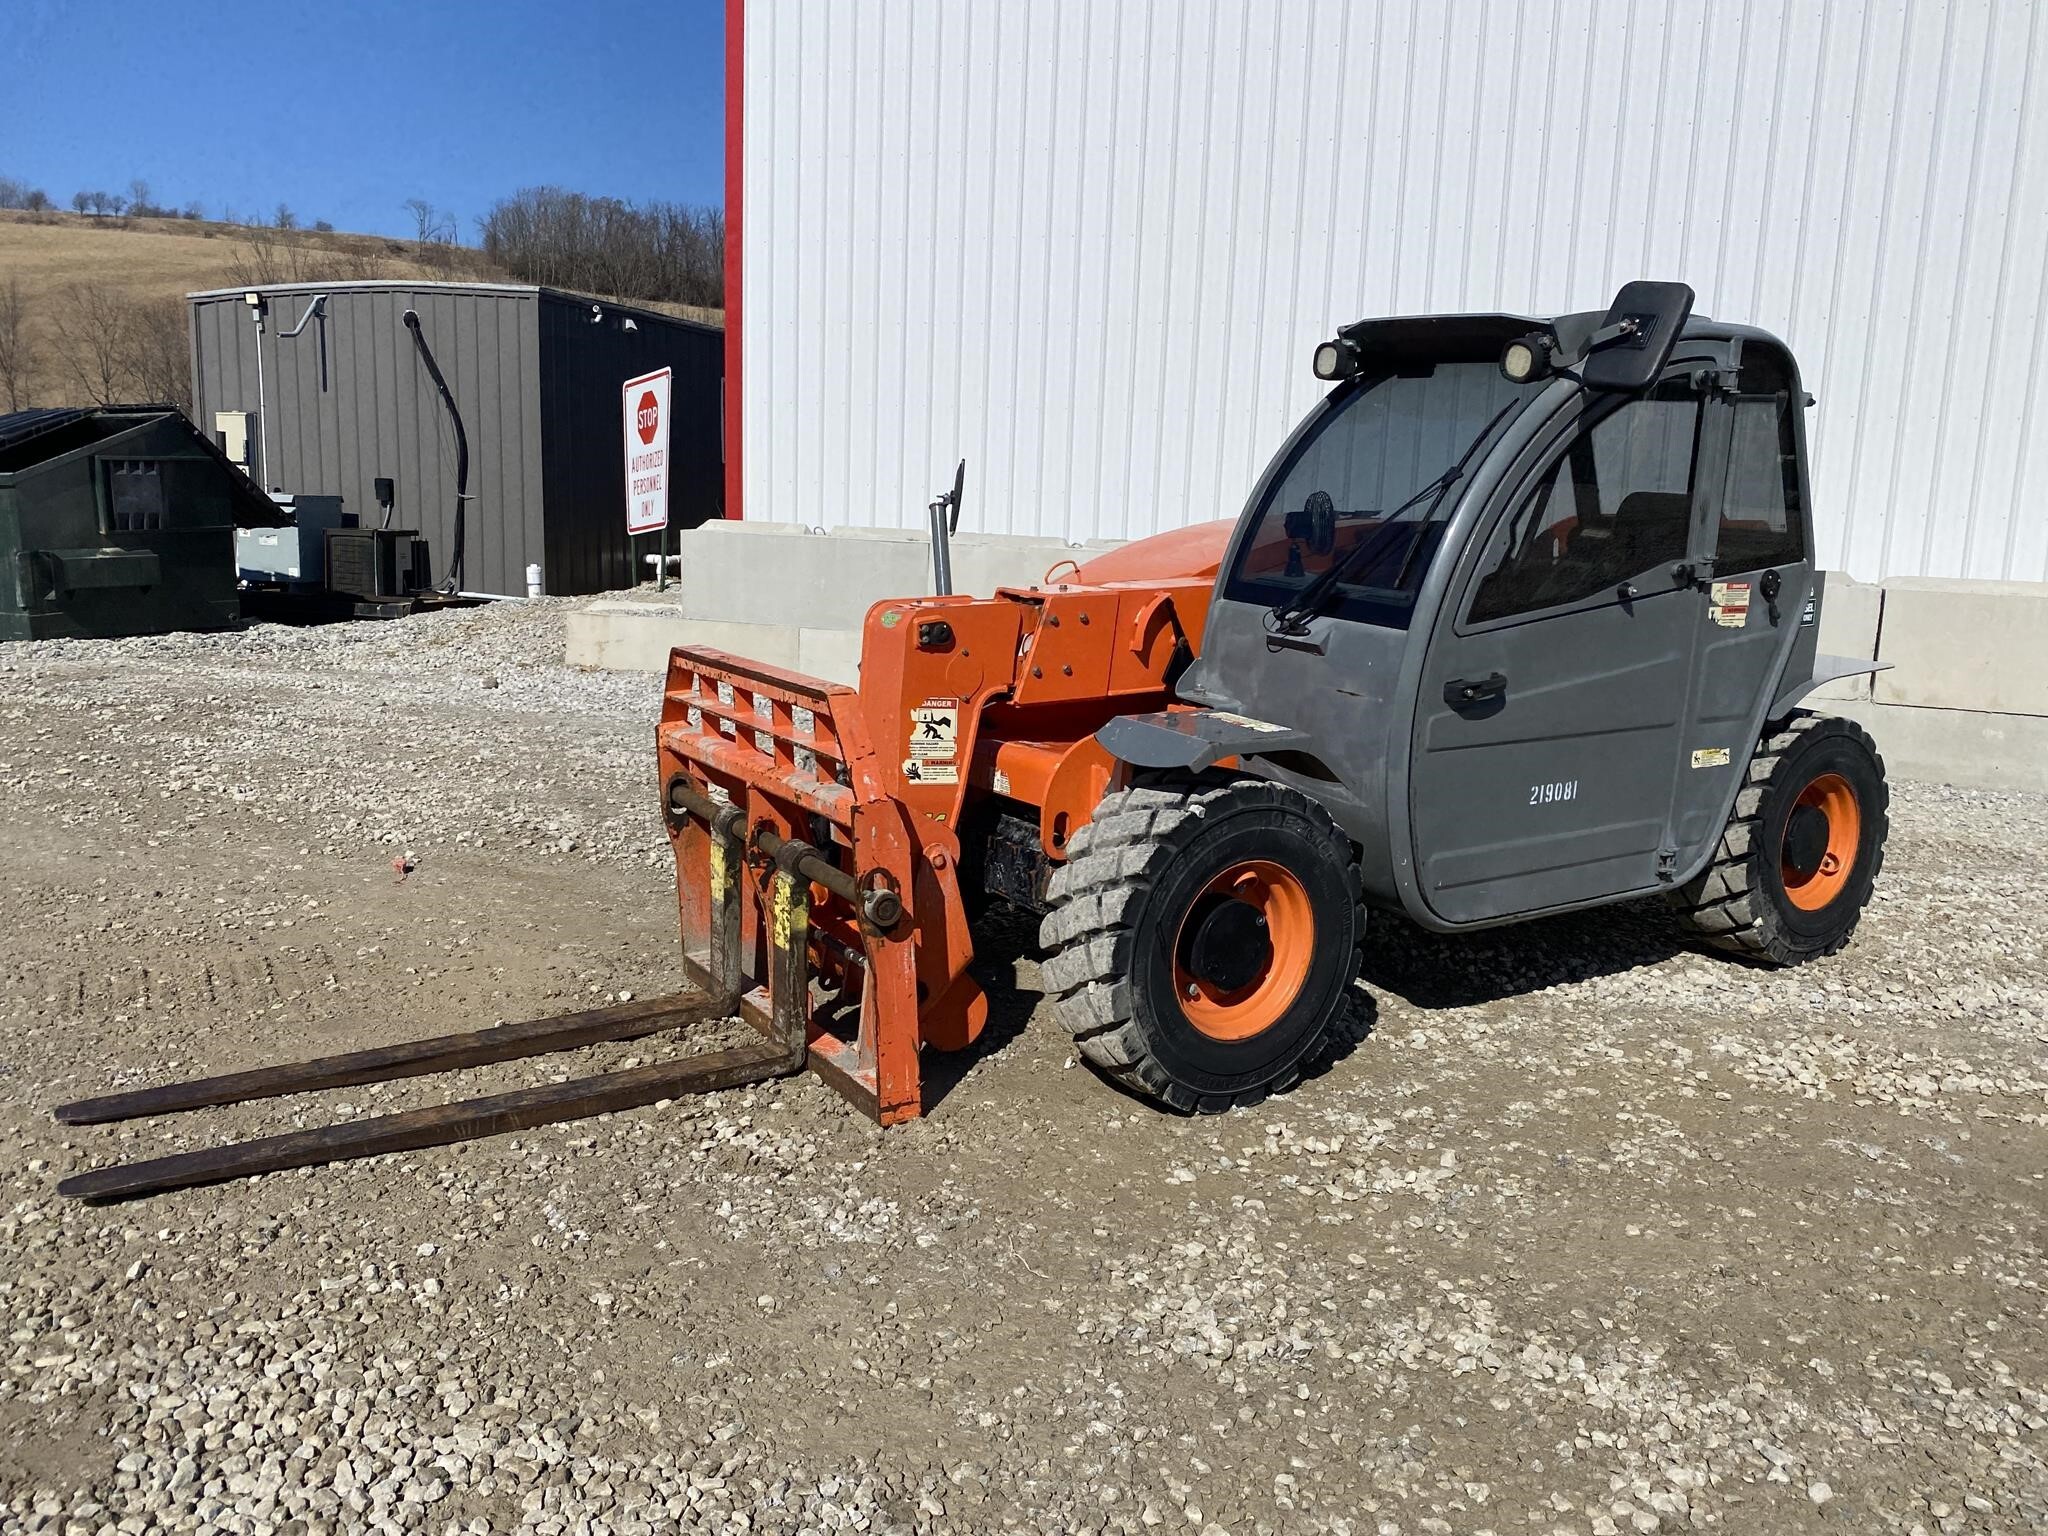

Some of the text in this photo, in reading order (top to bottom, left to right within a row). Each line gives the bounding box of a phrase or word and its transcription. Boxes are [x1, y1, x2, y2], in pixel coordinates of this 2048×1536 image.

[638, 406, 658, 430] STOP
[631, 450, 663, 473] AUTHORIZED
[633, 474, 662, 496] PERSONNEL
[641, 500, 655, 517] ONLY
[1529, 780, 1578, 805] 219081
